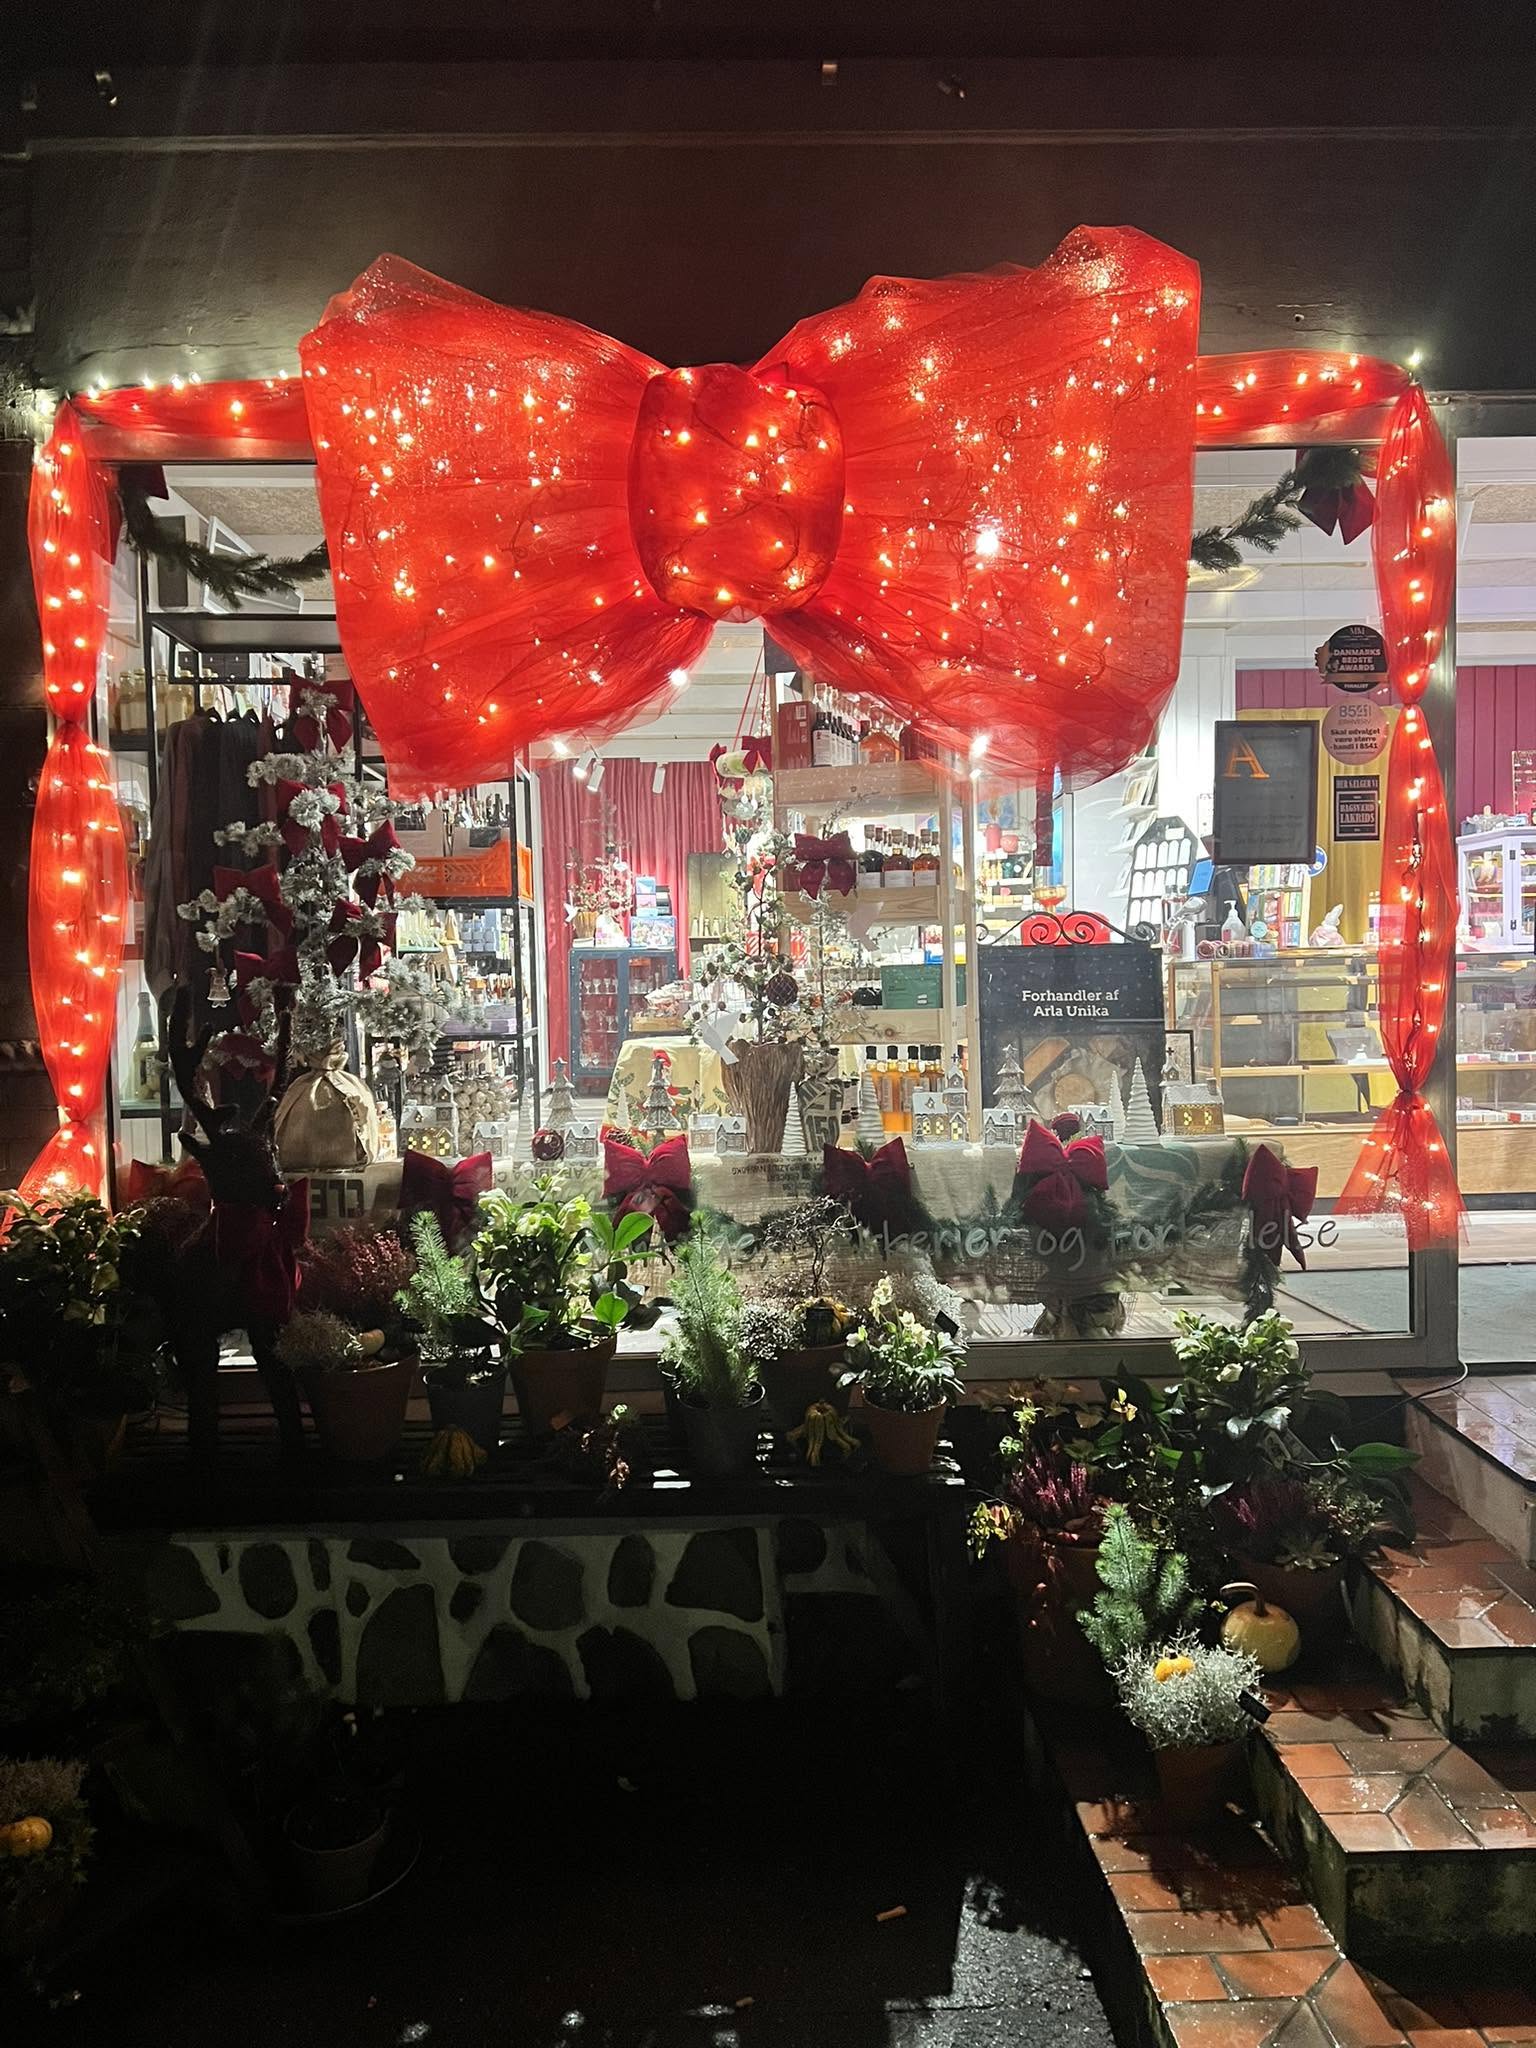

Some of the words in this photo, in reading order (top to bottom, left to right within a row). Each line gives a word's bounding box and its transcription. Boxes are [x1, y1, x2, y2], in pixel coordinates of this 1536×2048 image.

[1333, 648, 1381, 656] DANMARKS
[1341, 656, 1374, 664] BEDSTE
[1330, 728, 1347, 736] Skal
[1348, 727, 1380, 736] udvalget
[1222, 733, 1271, 779] A
[1340, 813, 1375, 824] LAKRIDS
[1022, 990, 1102, 1002] Forhandler
[1105, 989, 1120, 1001] af
[1033, 1005, 1063, 1017] Arla
[1066, 1004, 1110, 1017] Unika
[1035, 1226, 1086, 1272] og
